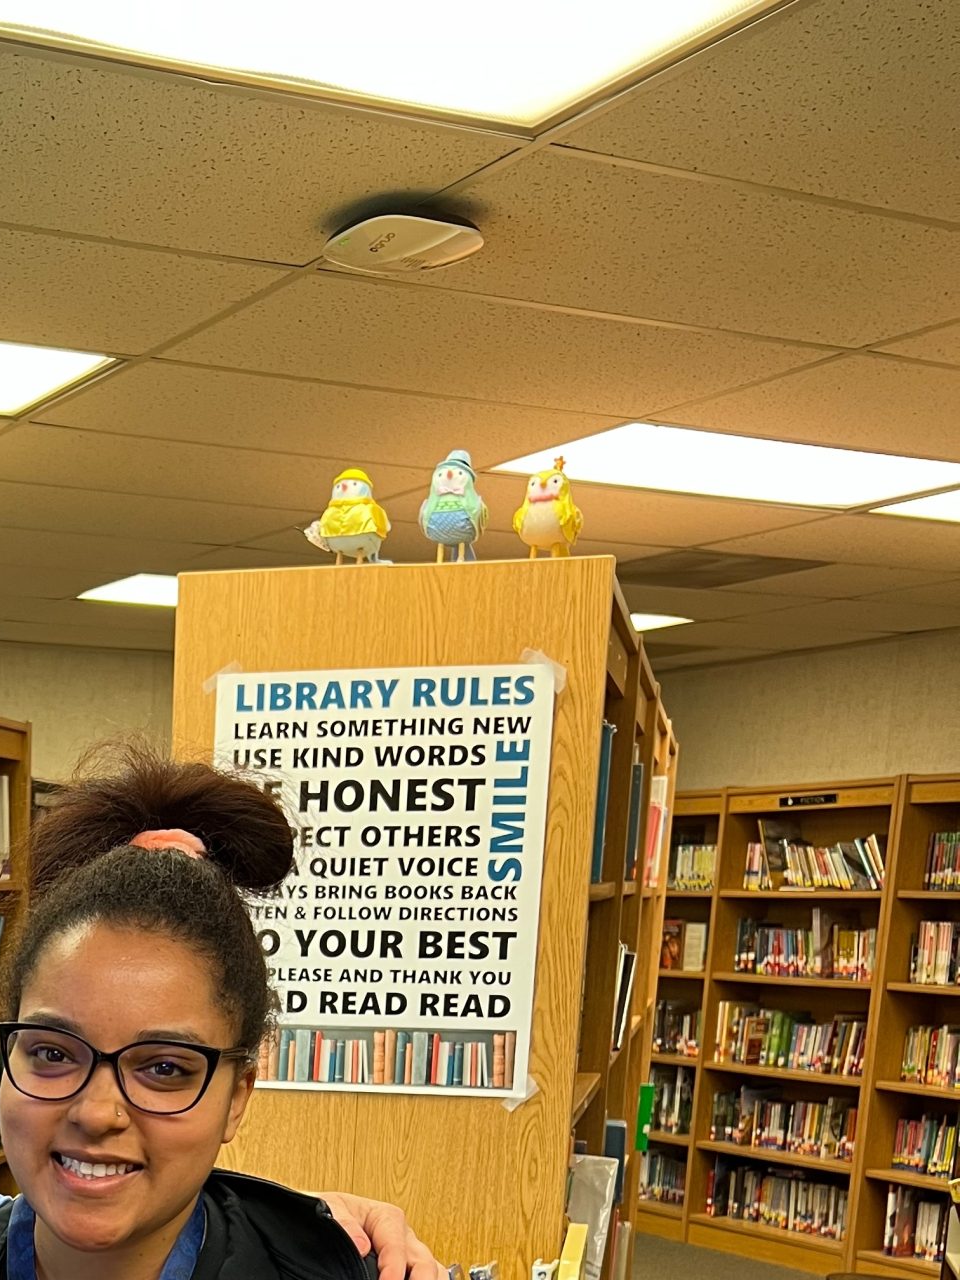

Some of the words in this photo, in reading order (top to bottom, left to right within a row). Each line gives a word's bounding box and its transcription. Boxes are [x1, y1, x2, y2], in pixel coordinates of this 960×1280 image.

[236, 678, 400, 712] LIBRARY
[412, 675, 535, 707] RULES
[234, 721, 308, 740] LEARN
[316, 717, 464, 739] SOMETHING
[472, 716, 532, 735] NEW
[233, 748, 283, 770] USE
[292, 747, 364, 769] KIND
[374, 744, 486, 767] WORDS
[298, 778, 486, 813] HONEST
[488, 738, 531, 882] SMILE
[360, 825, 481, 848] OTHERS
[309, 857, 388, 878] QUIET
[397, 857, 479, 877] VOICE
[315, 885, 378, 900] BRING
[384, 885, 454, 900] BOOKS
[460, 885, 517, 901] BACK
[294, 907, 306, 920] &
[314, 907, 392, 920] FOLLOW
[398, 907, 518, 922] DIRECTIONS
[256, 928, 281, 957] O
[294, 929, 404, 959] YOUR
[418, 930, 518, 961] BEST
[339, 968, 383, 983] AND
[390, 969, 462, 984] THANK
[468, 970, 512, 985] YOU
[319, 991, 407, 1016] READ
[419, 993, 512, 1018] READ
